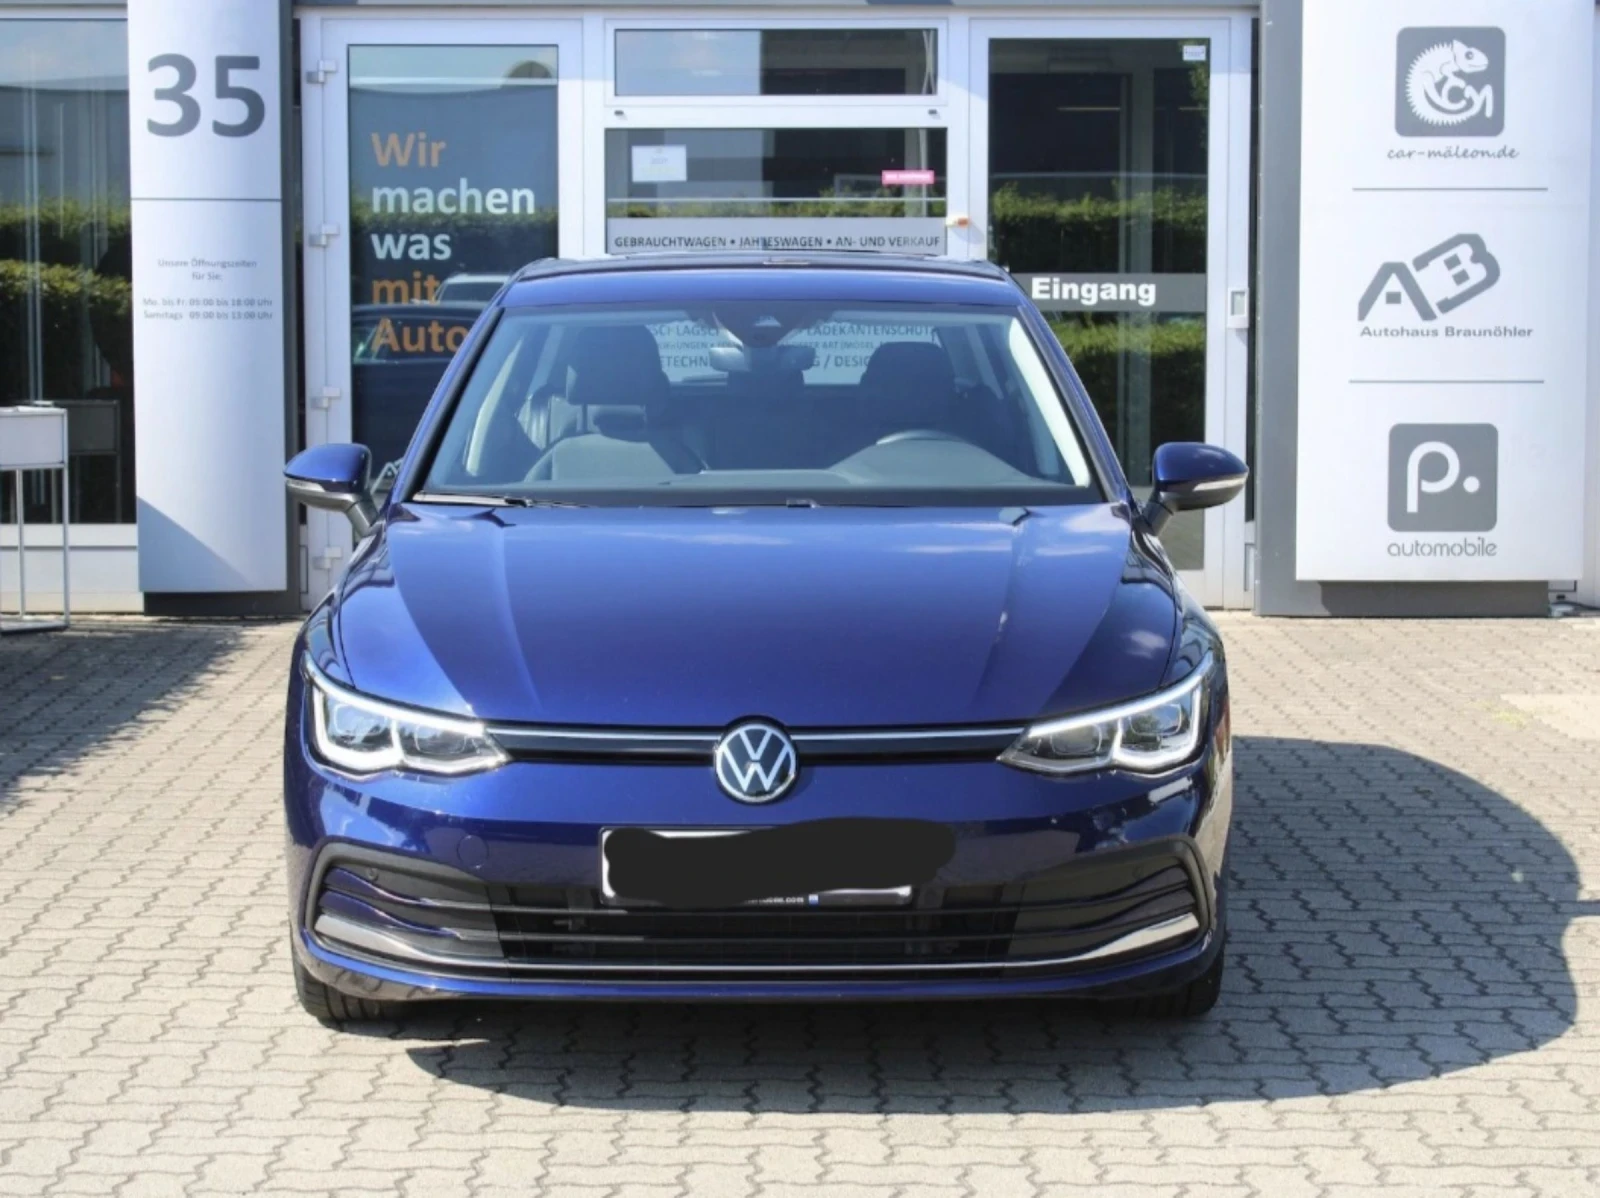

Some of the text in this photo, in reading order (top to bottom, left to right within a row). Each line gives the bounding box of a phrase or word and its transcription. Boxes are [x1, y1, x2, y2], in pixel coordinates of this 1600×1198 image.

[147, 53, 266, 137] 35
[370, 132, 446, 167] Wir
[1387, 144, 1520, 159] car-mäleon.de
[371, 178, 536, 214] machen
[370, 232, 453, 260] was
[614, 236, 727, 248] GEBRAUCHTWAGEN
[835, 236, 857, 247] AN-
[859, 236, 886, 247] UND
[888, 236, 941, 247] VERKAUF
[157, 256, 258, 270] Unsere Öffnungszeiten
[191, 271, 205, 281] für
[371, 270, 441, 305] mit
[1031, 277, 1157, 306] Eingang
[257, 297, 273, 306] Uhr
[257, 310, 273, 320] Uhr
[1360, 325, 1534, 338] Autohaus Braunöhler
[1387, 536, 1498, 557] automobile
